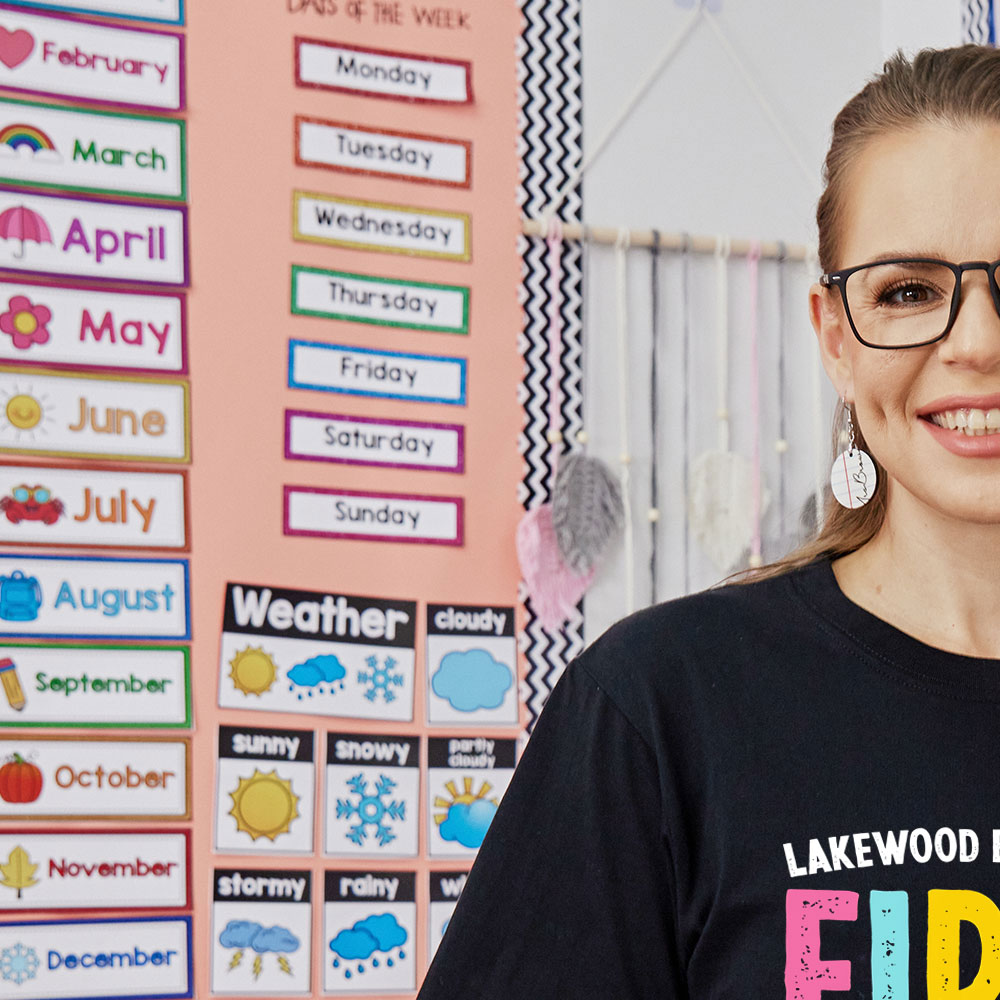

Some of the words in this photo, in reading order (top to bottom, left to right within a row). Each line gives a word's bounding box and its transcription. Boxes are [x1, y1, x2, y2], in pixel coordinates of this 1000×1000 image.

[373, 3, 403, 25] THE
[412, 5, 472, 30] WEEK
[43, 41, 168, 83] February
[336, 56, 432, 88] Monday
[72, 138, 167, 172] March
[337, 134, 433, 169] Tuesday
[315, 206, 452, 244] Wednesday
[62, 218, 166, 264] April
[329, 282, 438, 316] Thursday
[79, 308, 171, 356] May
[340, 357, 418, 388] Friday
[68, 397, 167, 438] June
[324, 425, 434, 457] Saturday
[73, 488, 156, 533] July
[335, 502, 420, 530] Sunday
[54, 580, 175, 617] August
[232, 586, 410, 641] Weather
[433, 608, 507, 635] cloudy
[36, 672, 172, 697] September
[231, 732, 300, 760] sunny
[334, 740, 410, 765] snowy
[448, 737, 496, 755] partly
[448, 753, 497, 769] cloudy
[55, 765, 175, 791] October
[783, 826, 979, 877] LAKEWOOD
[48, 857, 179, 880] November
[217, 873, 306, 901] stormy
[338, 873, 400, 901] rainy
[47, 946, 178, 971] December
